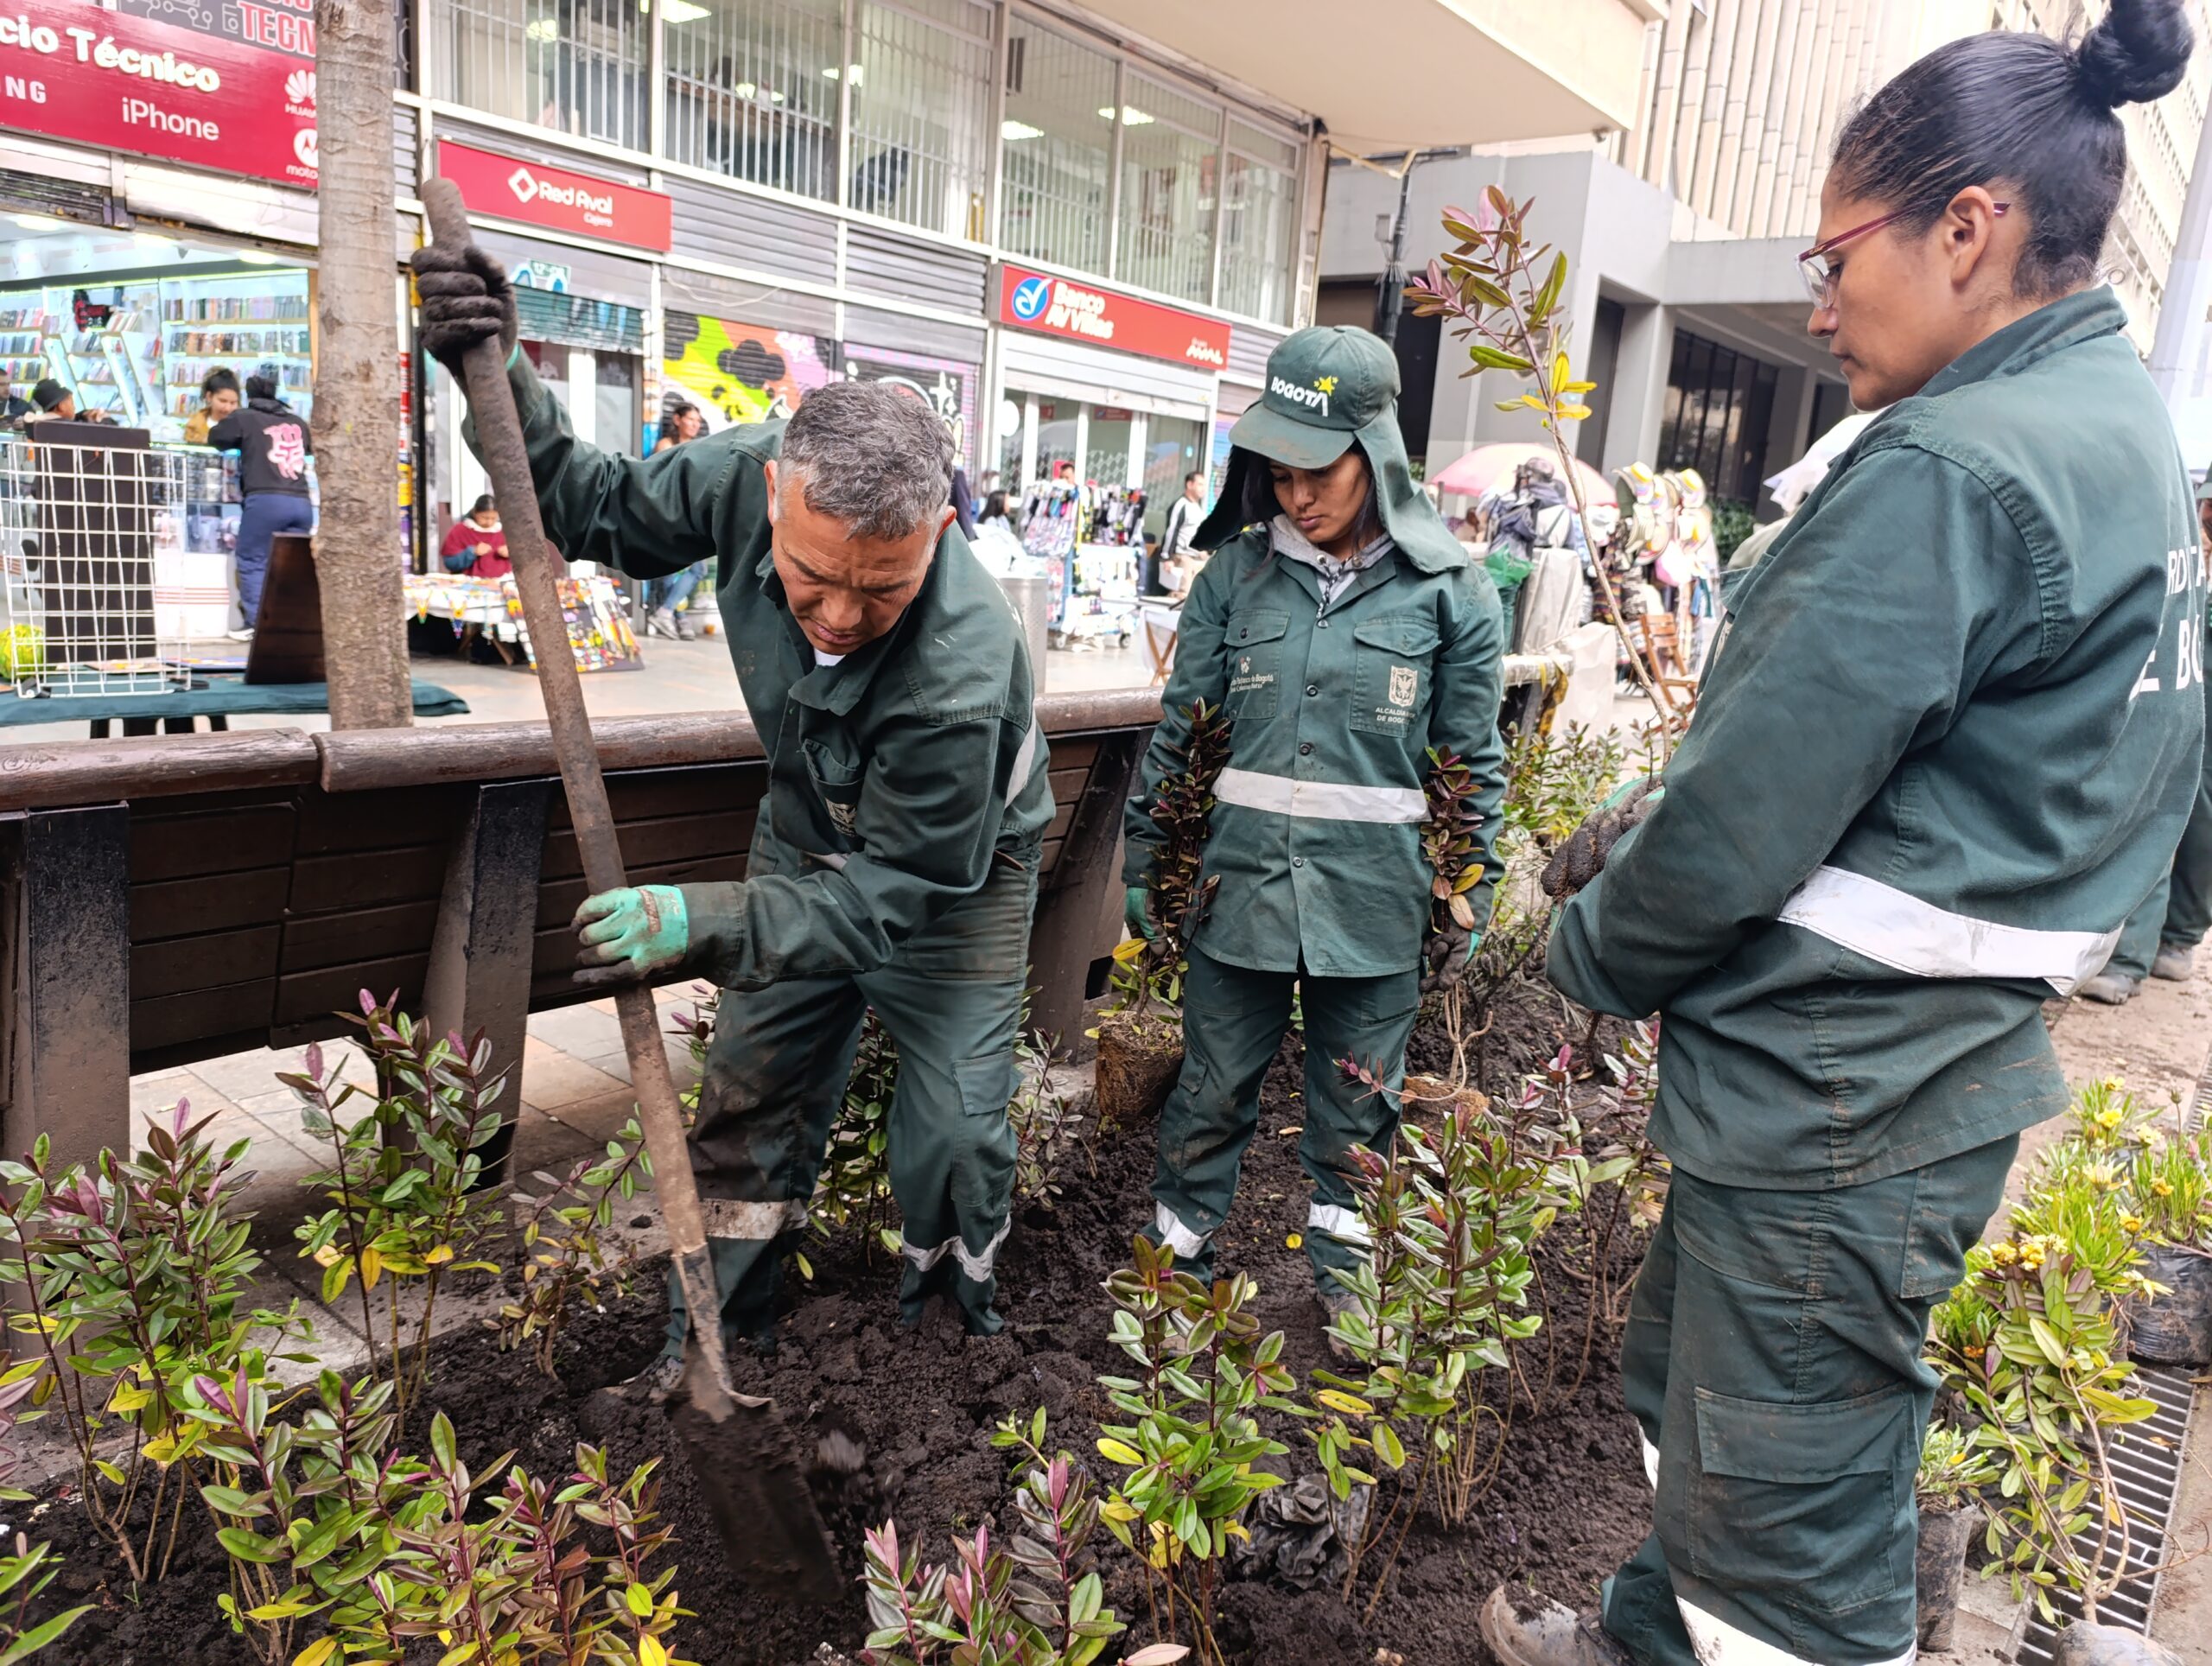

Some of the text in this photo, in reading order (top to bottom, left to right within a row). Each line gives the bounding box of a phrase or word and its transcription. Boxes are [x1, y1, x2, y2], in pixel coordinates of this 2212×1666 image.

[66, 28, 220, 92] Técnico
[122, 97, 219, 141] iPhone
[538, 180, 613, 215] Red Aval
[1053, 282, 1105, 315] Banco
